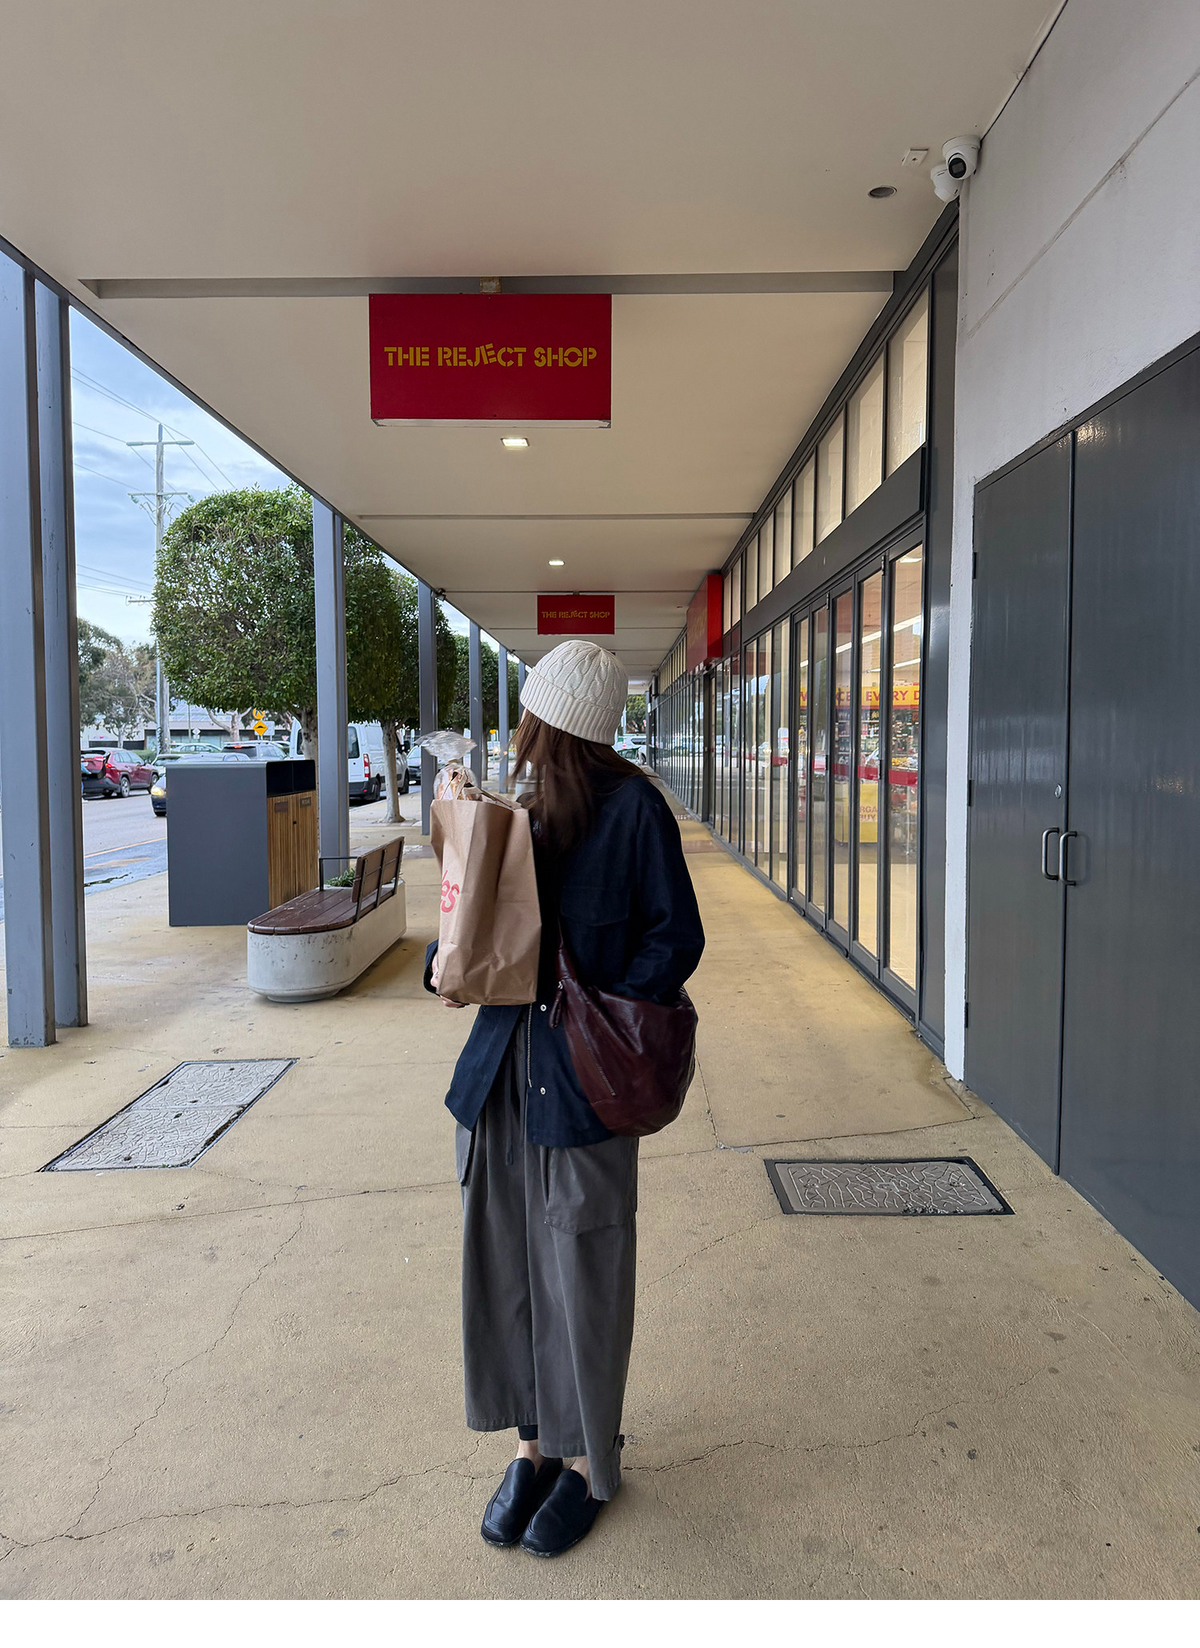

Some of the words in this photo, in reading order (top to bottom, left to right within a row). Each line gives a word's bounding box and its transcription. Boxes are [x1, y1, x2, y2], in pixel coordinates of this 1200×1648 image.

[384, 346, 430, 367] THE
[437, 343, 527, 367] REJECT
[533, 347, 598, 367] SHOP
[559, 610, 588, 618] REJECT
[865, 690, 908, 701] EVRY
